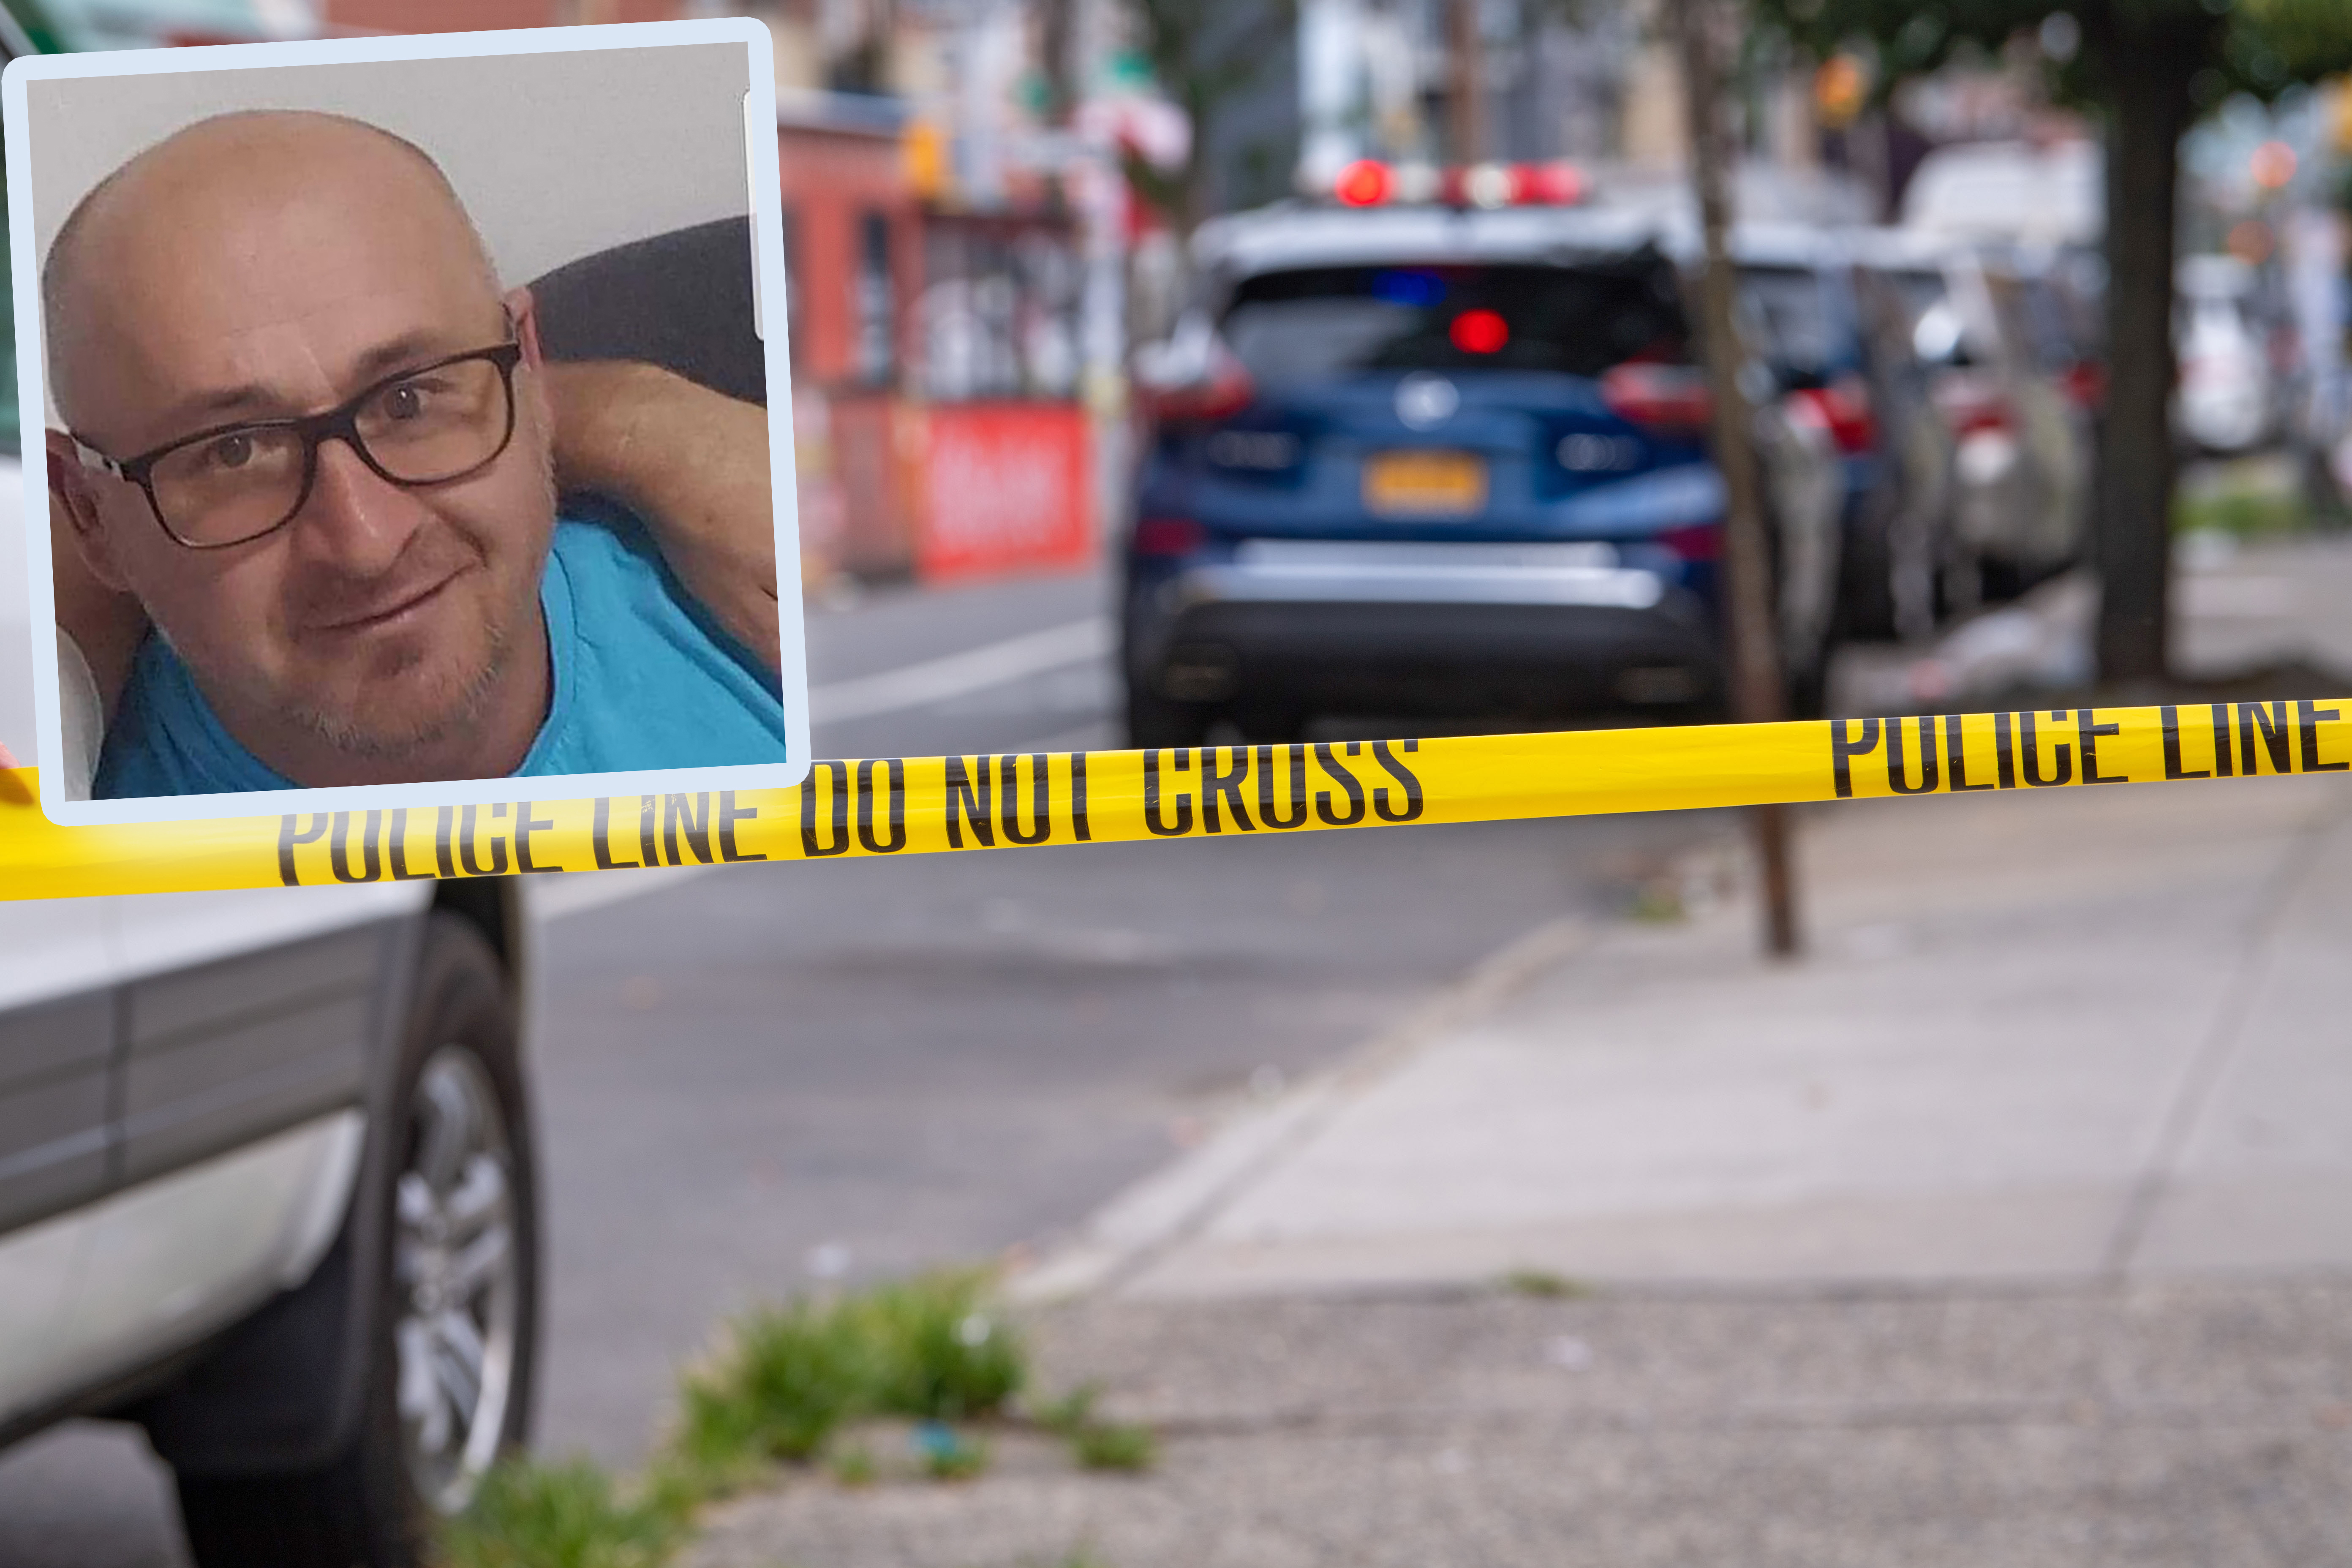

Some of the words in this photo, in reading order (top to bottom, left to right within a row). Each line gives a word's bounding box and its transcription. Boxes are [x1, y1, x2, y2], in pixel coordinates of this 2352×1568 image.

[1830, 709, 2129, 798] POLICE
[2160, 700, 2351, 780] LINE
[277, 801, 564, 887] POLICE
[592, 790, 767, 870] LINE
[800, 759, 905, 857] DO
[945, 751, 1091, 849] NOT
[1143, 739, 1424, 836] CROSS
